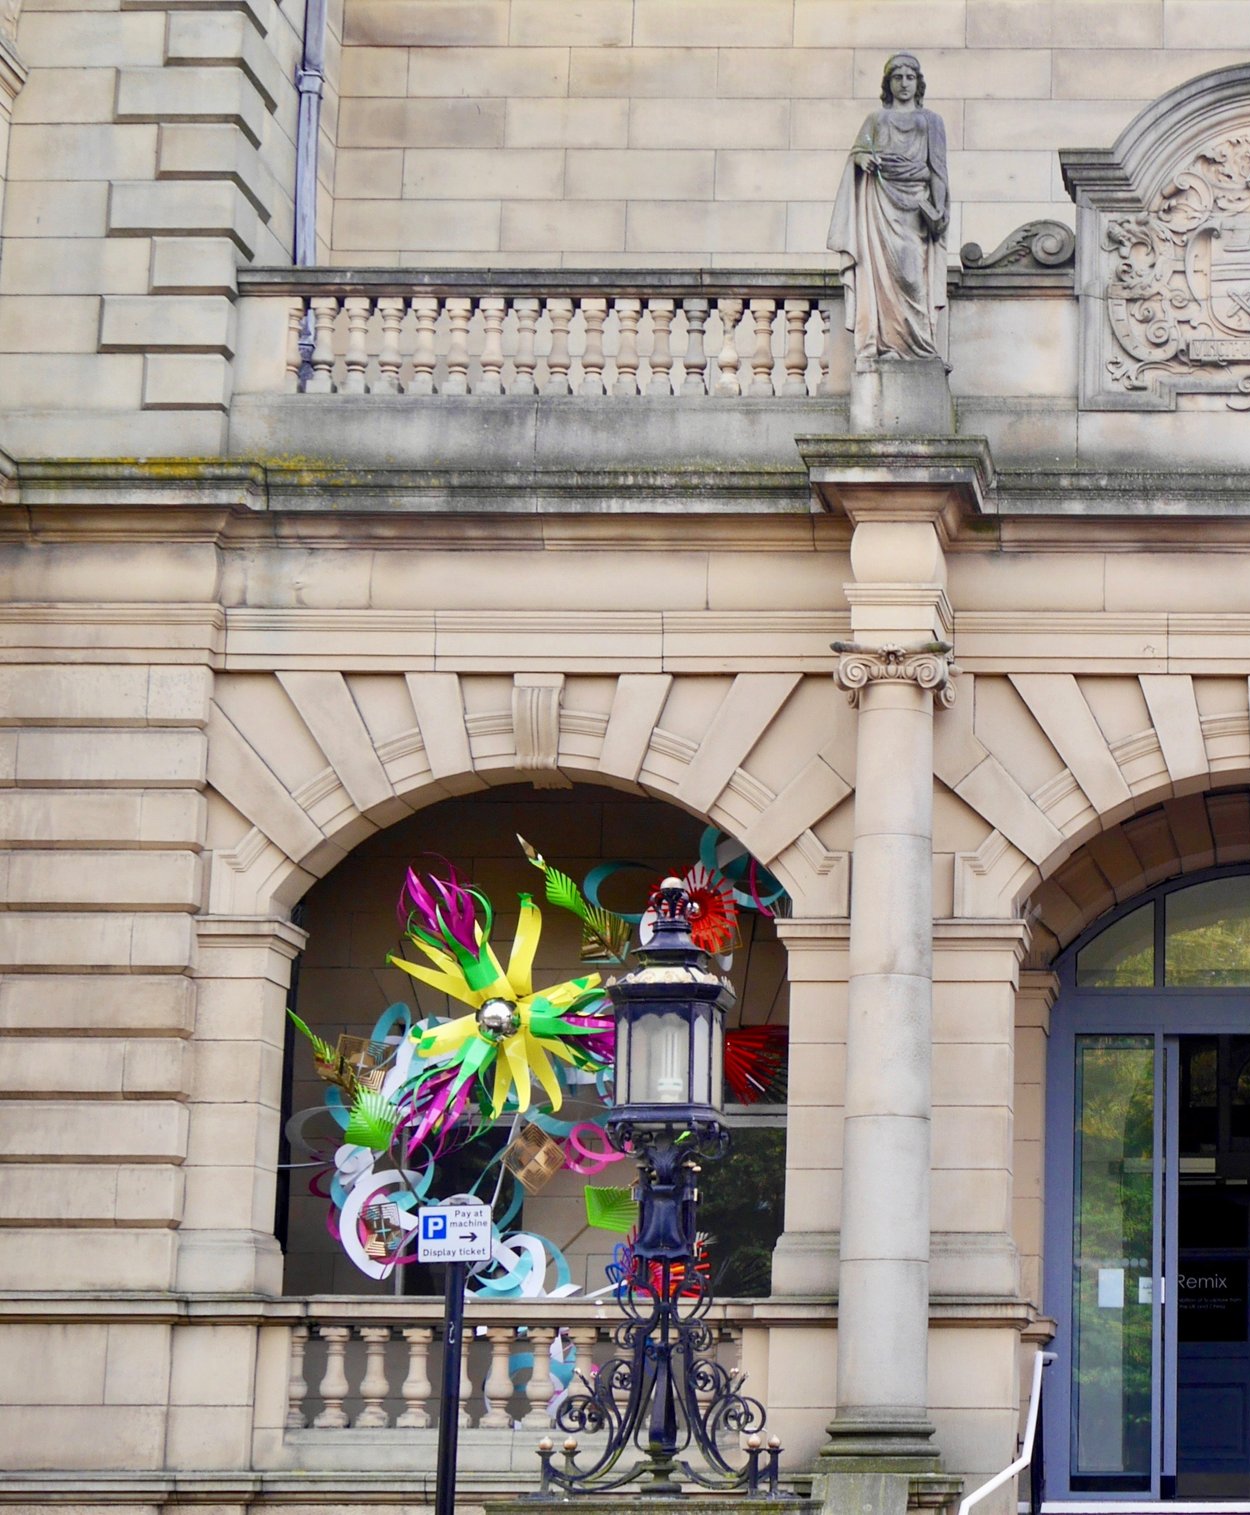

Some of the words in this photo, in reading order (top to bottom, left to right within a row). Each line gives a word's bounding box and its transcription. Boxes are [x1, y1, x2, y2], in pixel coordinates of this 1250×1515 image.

[454, 1210, 471, 1218] Pay
[428, 1217, 444, 1238] P
[449, 1220, 488, 1228] machine
[422, 1248, 457, 1257] Display
[459, 1247, 486, 1256] ticket
[1178, 1273, 1228, 1289] Remix
